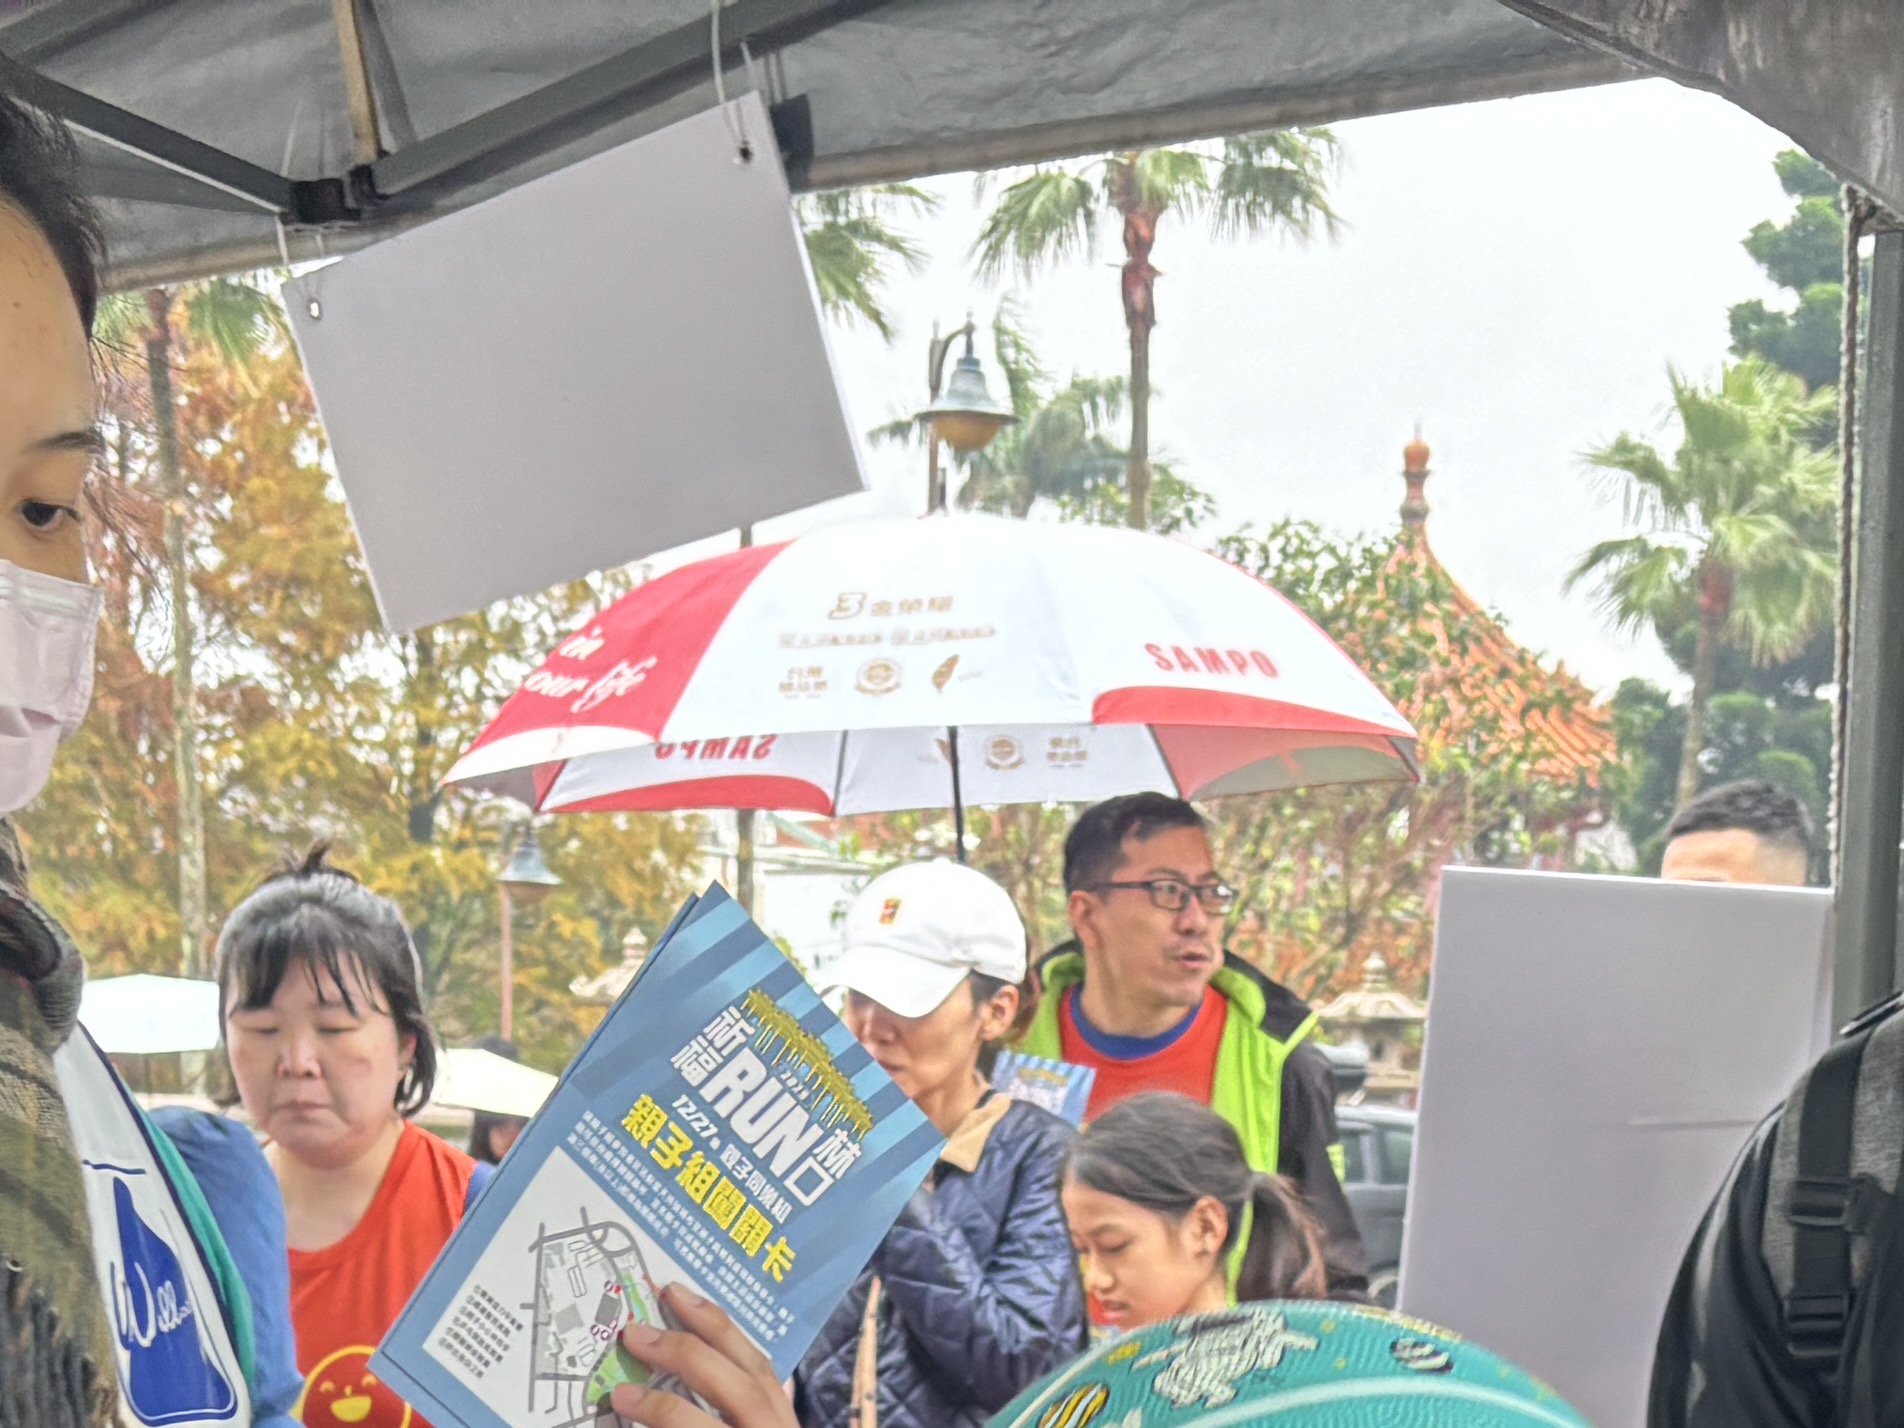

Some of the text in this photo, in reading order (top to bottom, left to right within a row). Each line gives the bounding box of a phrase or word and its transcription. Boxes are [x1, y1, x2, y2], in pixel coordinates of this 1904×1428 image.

[1144, 642, 1279, 679] SAMPO
[672, 1094, 718, 1138] 12/27
[699, 1047, 824, 1177] RUN
